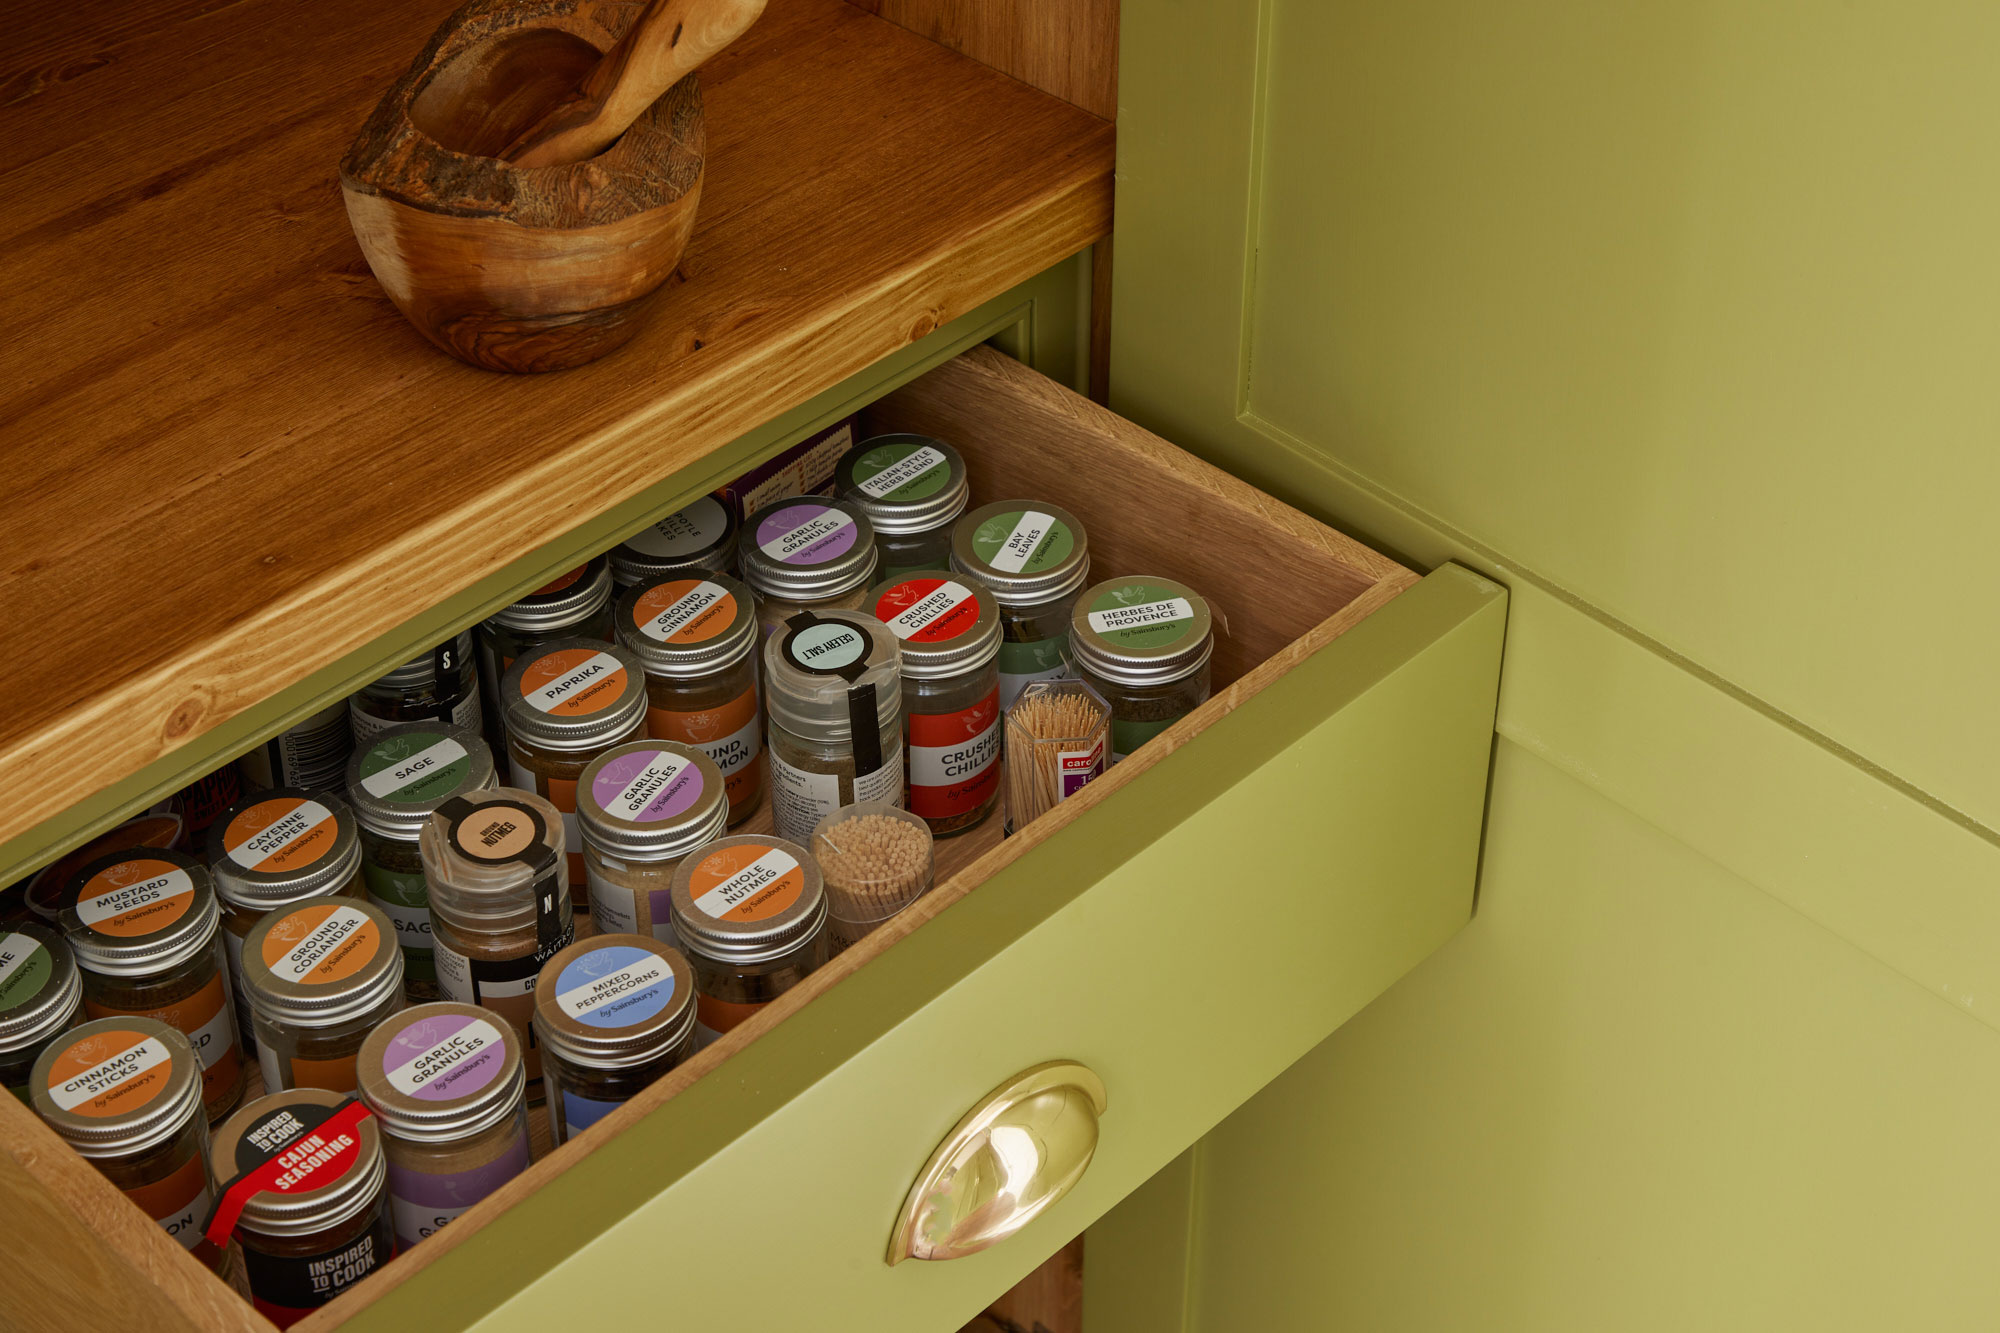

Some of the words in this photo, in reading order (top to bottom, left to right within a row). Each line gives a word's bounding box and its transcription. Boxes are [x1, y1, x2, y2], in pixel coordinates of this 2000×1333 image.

[864, 450, 932, 490] ITALIAN-STYLE
[878, 475, 905, 492] HERB
[904, 457, 934, 477] BLEND
[674, 513, 701, 537] POTLE
[782, 521, 839, 553] GRANULES
[783, 520, 823, 544] GARLIC
[1008, 532, 1025, 549] BAY
[809, 532, 845, 554] Sainsbury's
[1015, 529, 1040, 558] LEAVES
[657, 593, 700, 625] GROUND
[661, 593, 716, 633] CINNAMON
[691, 604, 724, 630] Sainsbury's
[899, 592, 946, 625] CRUSHED
[910, 598, 954, 629] CHILLIES
[1102, 606, 1153, 620] HERBES
[1157, 602, 1175, 613] DE
[1106, 610, 1178, 627] PROVENCE
[823, 633, 854, 652] CELERY
[1120, 630, 1131, 638] by
[1130, 623, 1176, 635] Sainsbury's
[802, 645, 825, 660] SALT
[545, 665, 604, 699] PAPRIKA
[577, 678, 615, 703] Sainsbury's
[395, 757, 435, 780] SAGE
[413, 767, 456, 791] Sainsbury's
[624, 767, 660, 800] GARLIC
[628, 765, 677, 811] GRANULES
[650, 804, 663, 814] by
[659, 776, 689, 806] Sainsbury's
[247, 812, 304, 850] CAYENNE
[261, 822, 308, 853] PEPPER
[273, 854, 285, 863] by
[283, 829, 324, 857] Sainsbury's
[481, 822, 517, 847] NUTMEG
[96, 879, 169, 908] MUSTARD
[718, 865, 765, 895] WHOLE
[725, 869, 777, 904] NUTMEG
[114, 890, 160, 911] SEEDS
[741, 905, 753, 914] by
[750, 880, 791, 907] Sainsbury's
[113, 918, 125, 927] by
[125, 901, 175, 922] Sainsbury's
[393, 919, 432, 933] SAG
[291, 921, 339, 961] GROUND
[294, 919, 359, 974] CORIANDER
[320, 965, 333, 974] by
[329, 935, 366, 967] Sainsbury's
[575, 970, 660, 1010] PEPPERCORNS
[592, 973, 630, 992] MIXED
[600, 1009, 611, 1018] by
[610, 989, 659, 1012] Sainsbury's
[64, 1047, 147, 1092] CINNAMON
[412, 1038, 484, 1083] GRANULES
[414, 1037, 465, 1070] GARLIC
[87, 1064, 138, 1092] STICKS
[434, 1082, 446, 1091] by
[445, 1054, 490, 1084] Sainsbury's
[94, 1099, 106, 1108] by
[105, 1074, 155, 1101] Sainsbury's
[247, 1111, 293, 1144] INSPIRED
[256, 1139, 272, 1151] TO
[269, 1117, 304, 1145] COOK
[275, 1134, 354, 1190] SEASONING
[278, 1134, 325, 1169] CAJUN
[308, 1235, 373, 1277] INSPIRED
[311, 1275, 329, 1289] TO
[332, 1248, 376, 1287] COOK
